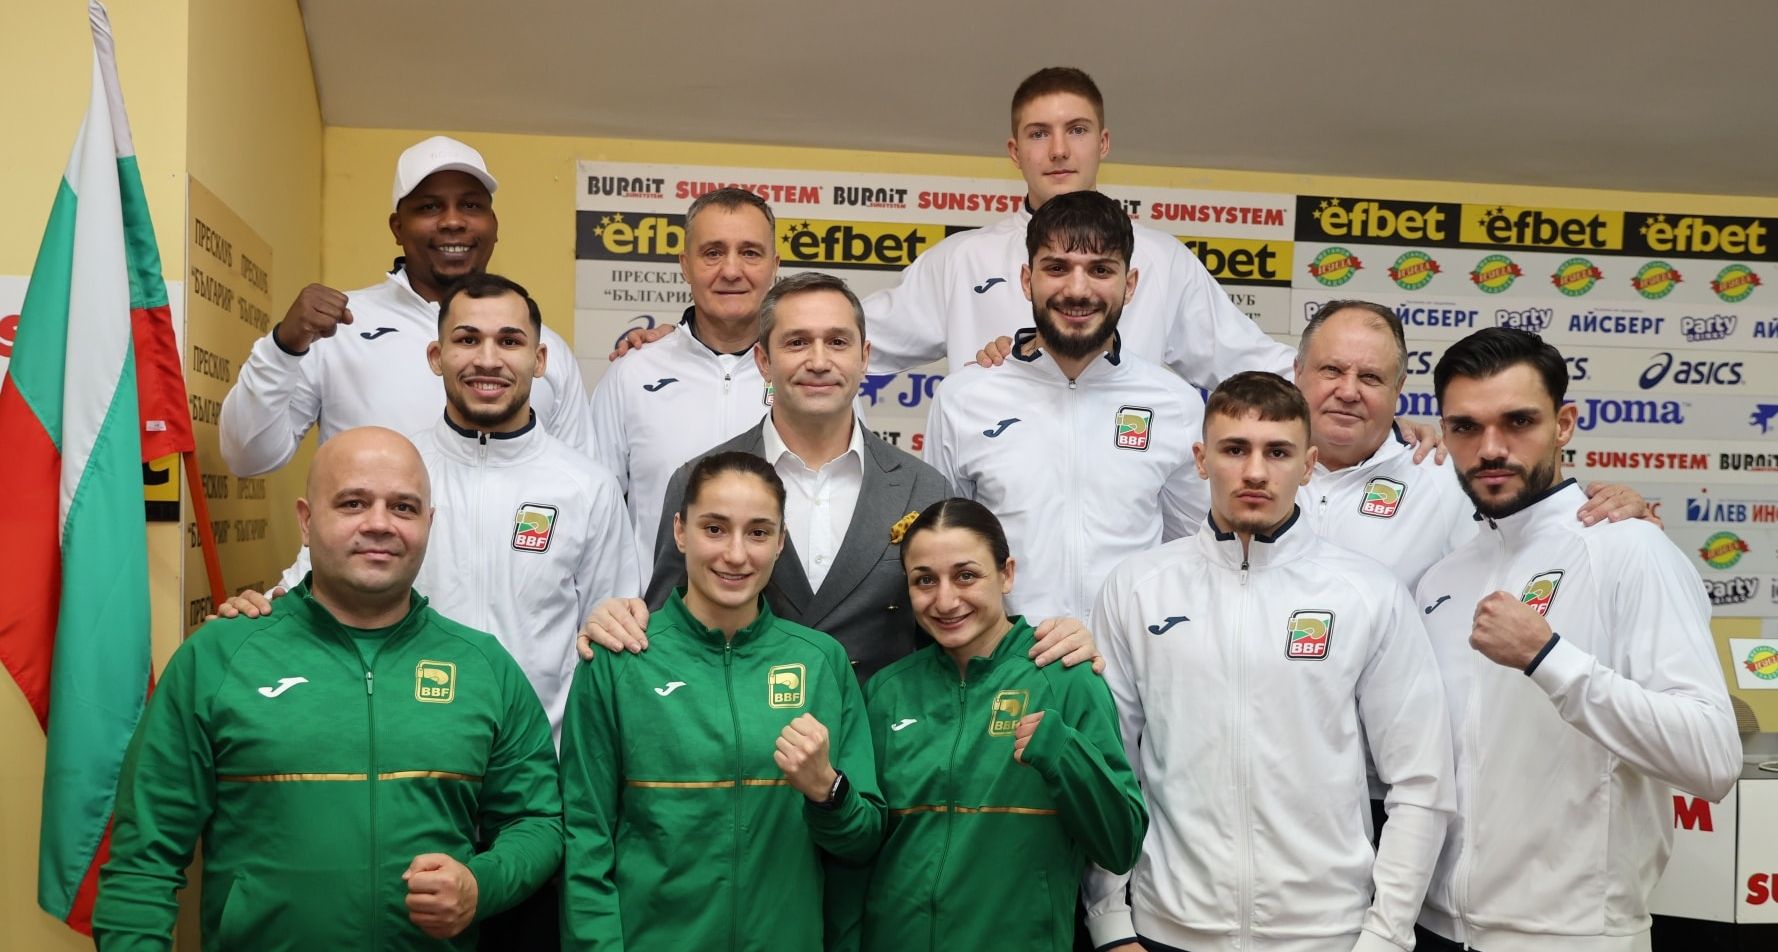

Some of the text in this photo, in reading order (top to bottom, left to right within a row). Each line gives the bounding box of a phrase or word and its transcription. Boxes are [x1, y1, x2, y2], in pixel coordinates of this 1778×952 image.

[918, 191, 1023, 213] SUNSYST
[1151, 202, 1285, 226] SUNSYSTEM
[1320, 201, 1446, 241] efbet
[602, 216, 686, 256] efb
[1486, 210, 1607, 248] efbet
[1646, 217, 1768, 255] efbet
[790, 225, 927, 264] efbet
[1184, 241, 1277, 279] bet
[612, 270, 686, 284] ПРЕСКЛУ
[1396, 303, 1479, 328] ЙСБЕРГ
[1495, 307, 1553, 330] Party
[1568, 311, 1665, 335] АЙСБЕРГ
[1680, 314, 1738, 336] Party
[1577, 398, 1685, 431] Joma
[1119, 435, 1147, 446] BBF
[1586, 450, 1709, 470] SUNSYSTEM
[1363, 502, 1396, 516] BBF
[1714, 503, 1778, 523] ЛЕВ ИН
[515, 534, 548, 547] BBF
[1291, 642, 1326, 654] BBF
[421, 686, 450, 698] BBF
[774, 692, 801, 703] BBF
